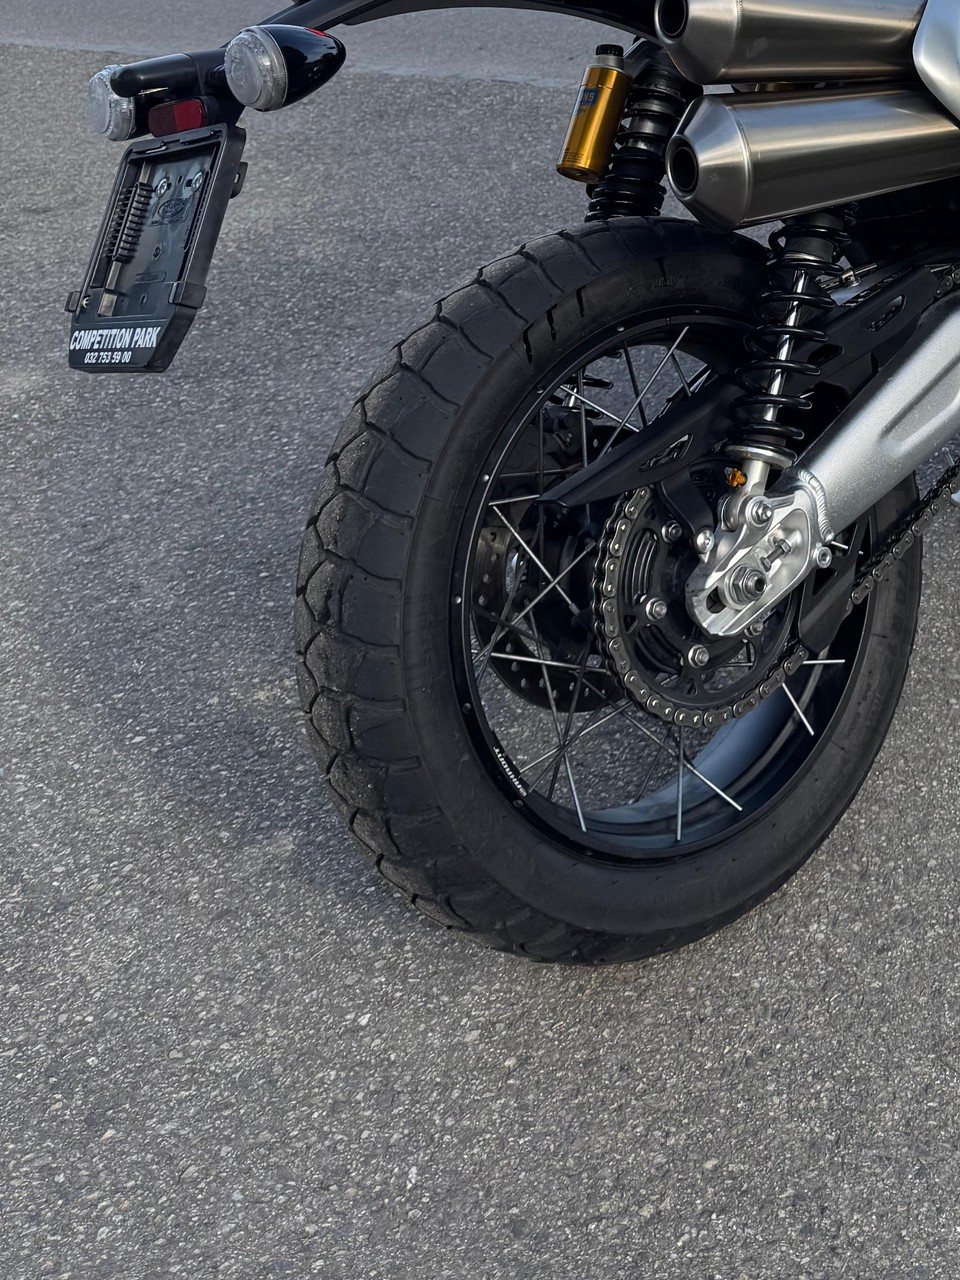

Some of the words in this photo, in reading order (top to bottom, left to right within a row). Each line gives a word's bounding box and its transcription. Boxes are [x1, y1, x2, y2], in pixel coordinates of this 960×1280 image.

[69, 328, 134, 350] COMPETITION
[131, 326, 161, 348] PARK
[84, 352, 98, 364] 032
[98, 351, 111, 363] 753
[111, 351, 122, 363] 59
[121, 351, 132, 363] 00
